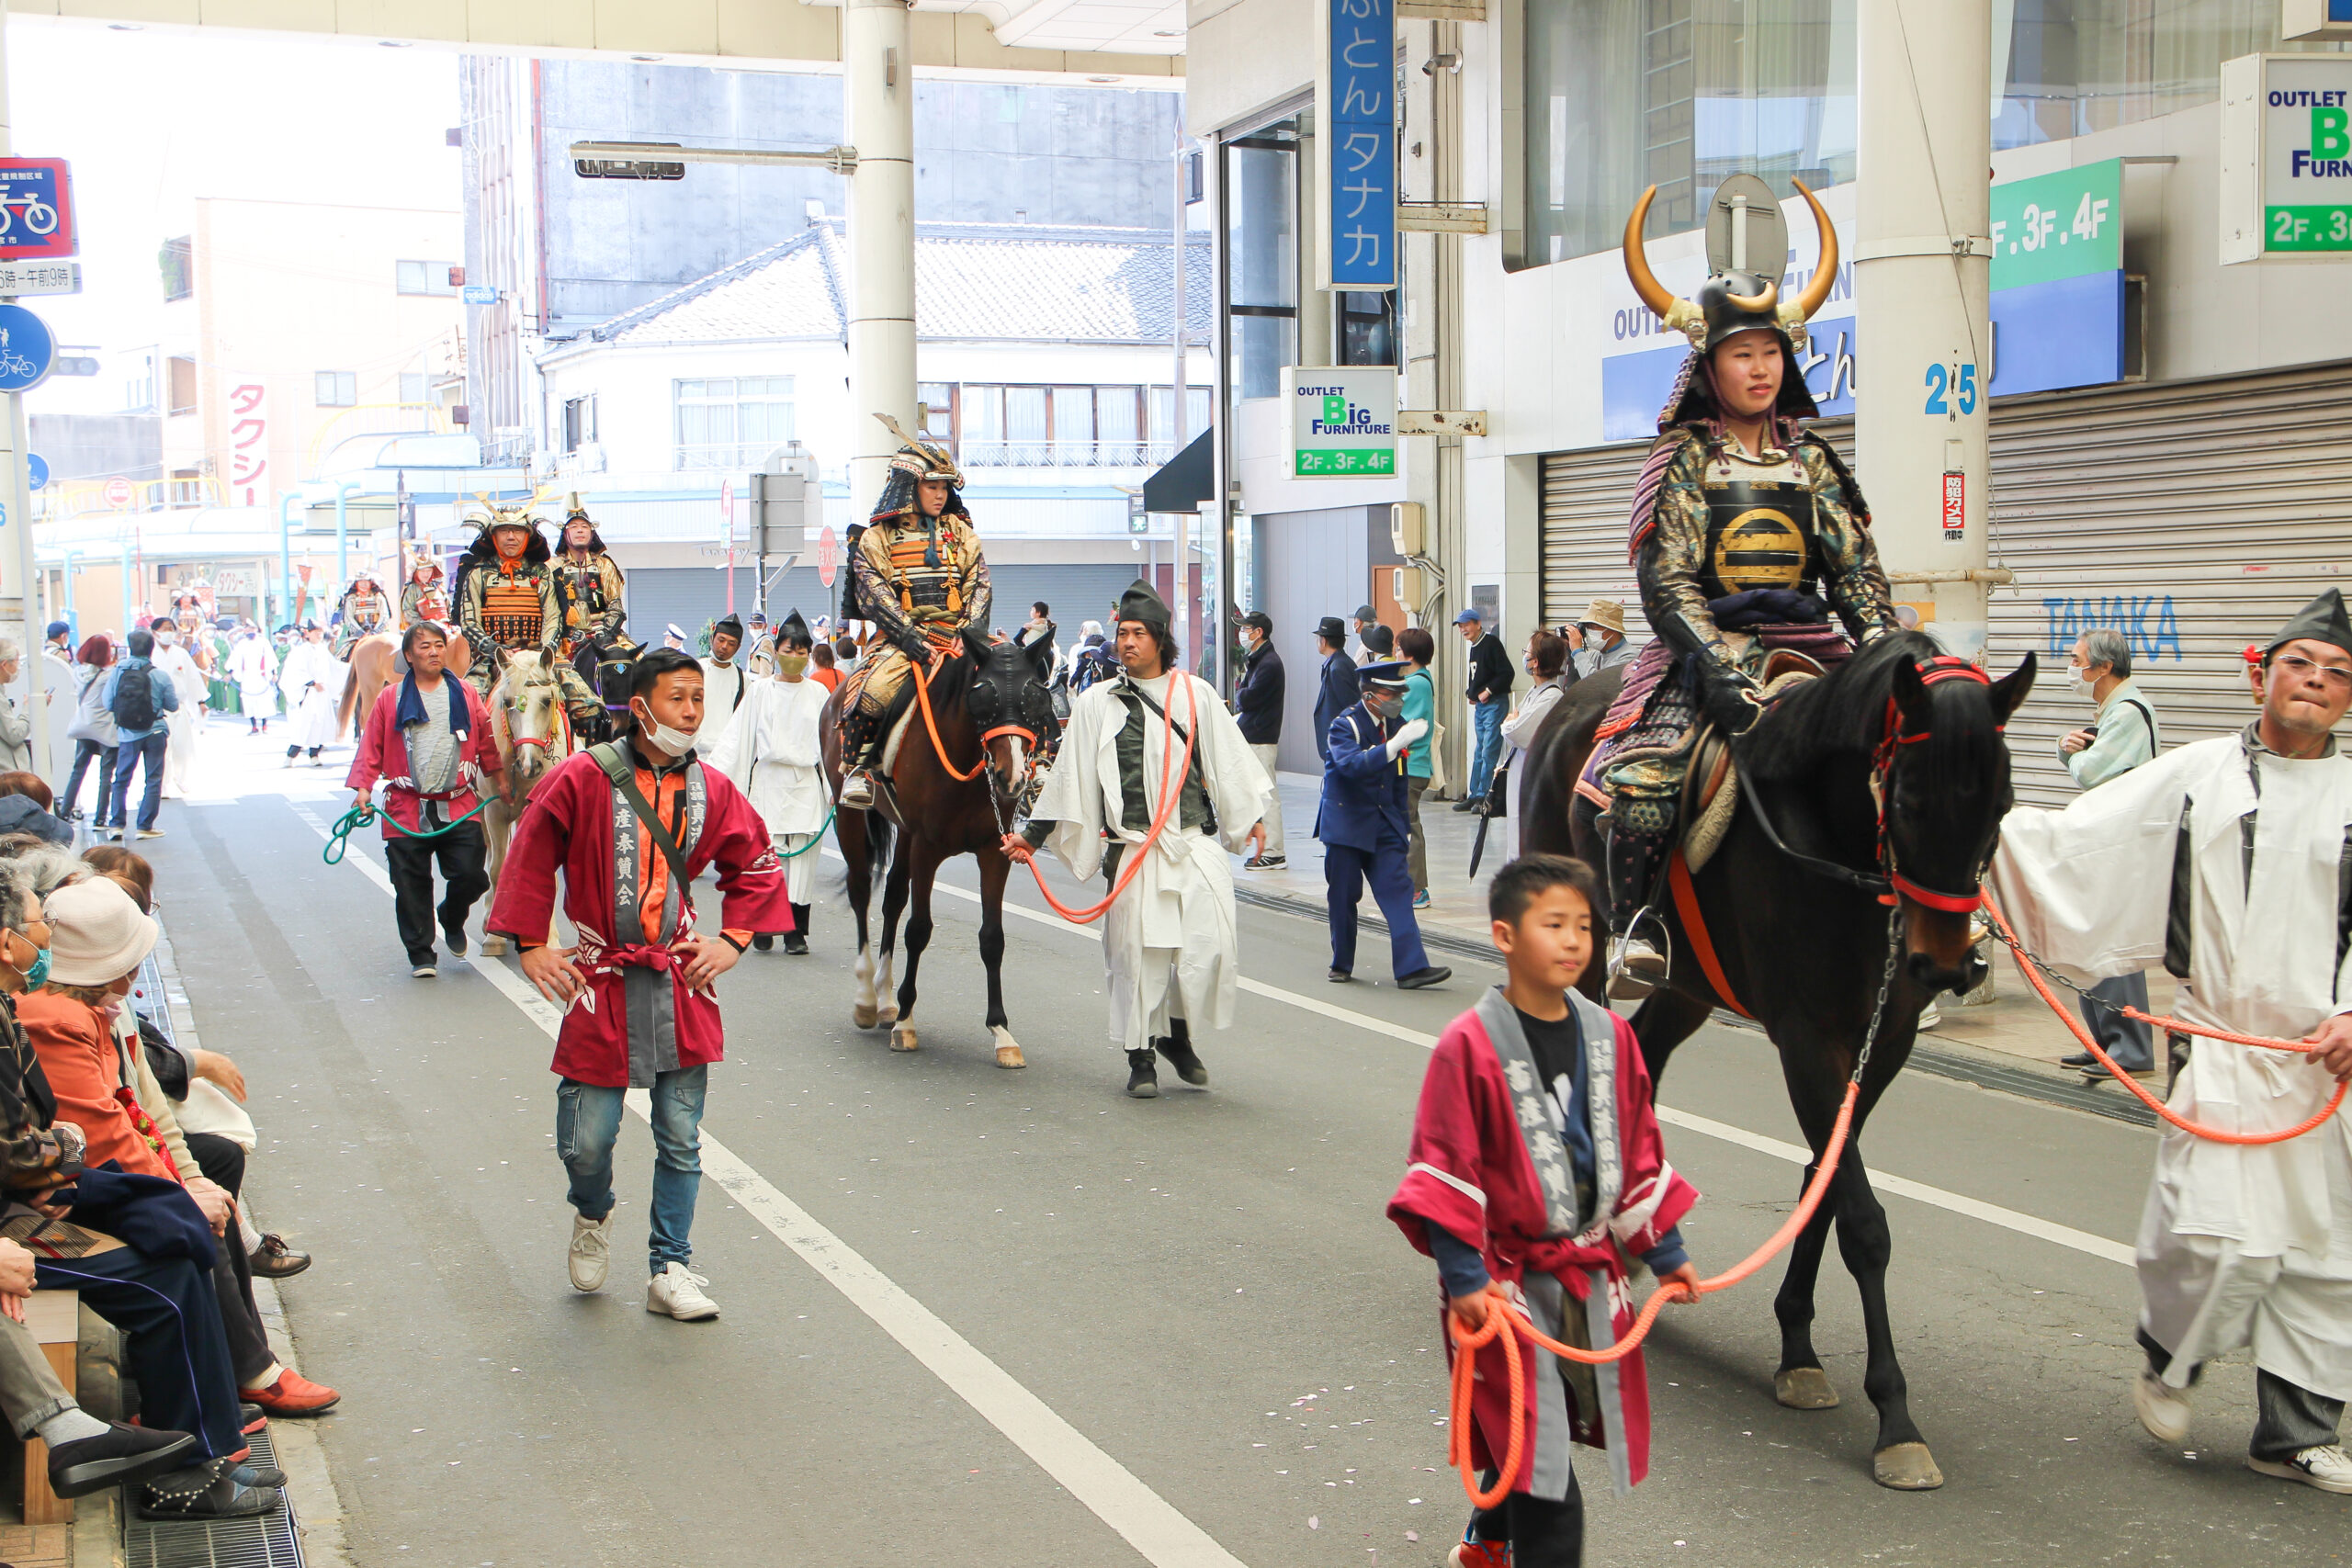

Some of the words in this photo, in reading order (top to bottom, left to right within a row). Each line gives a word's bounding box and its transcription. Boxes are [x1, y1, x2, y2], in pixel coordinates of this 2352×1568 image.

[2268, 91, 2346, 107] OUTLET
[2273, 210, 2352, 242] 2F.3
[1297, 387, 1344, 396] OUTLET
[1312, 419, 1390, 434] FURNITURE
[231, 384, 266, 505] タクシー
[1946, 477, 1962, 527] 防犯カメラ
[1945, 530, 1963, 540] 作動中
[2042, 595, 2182, 662] TANAKA
